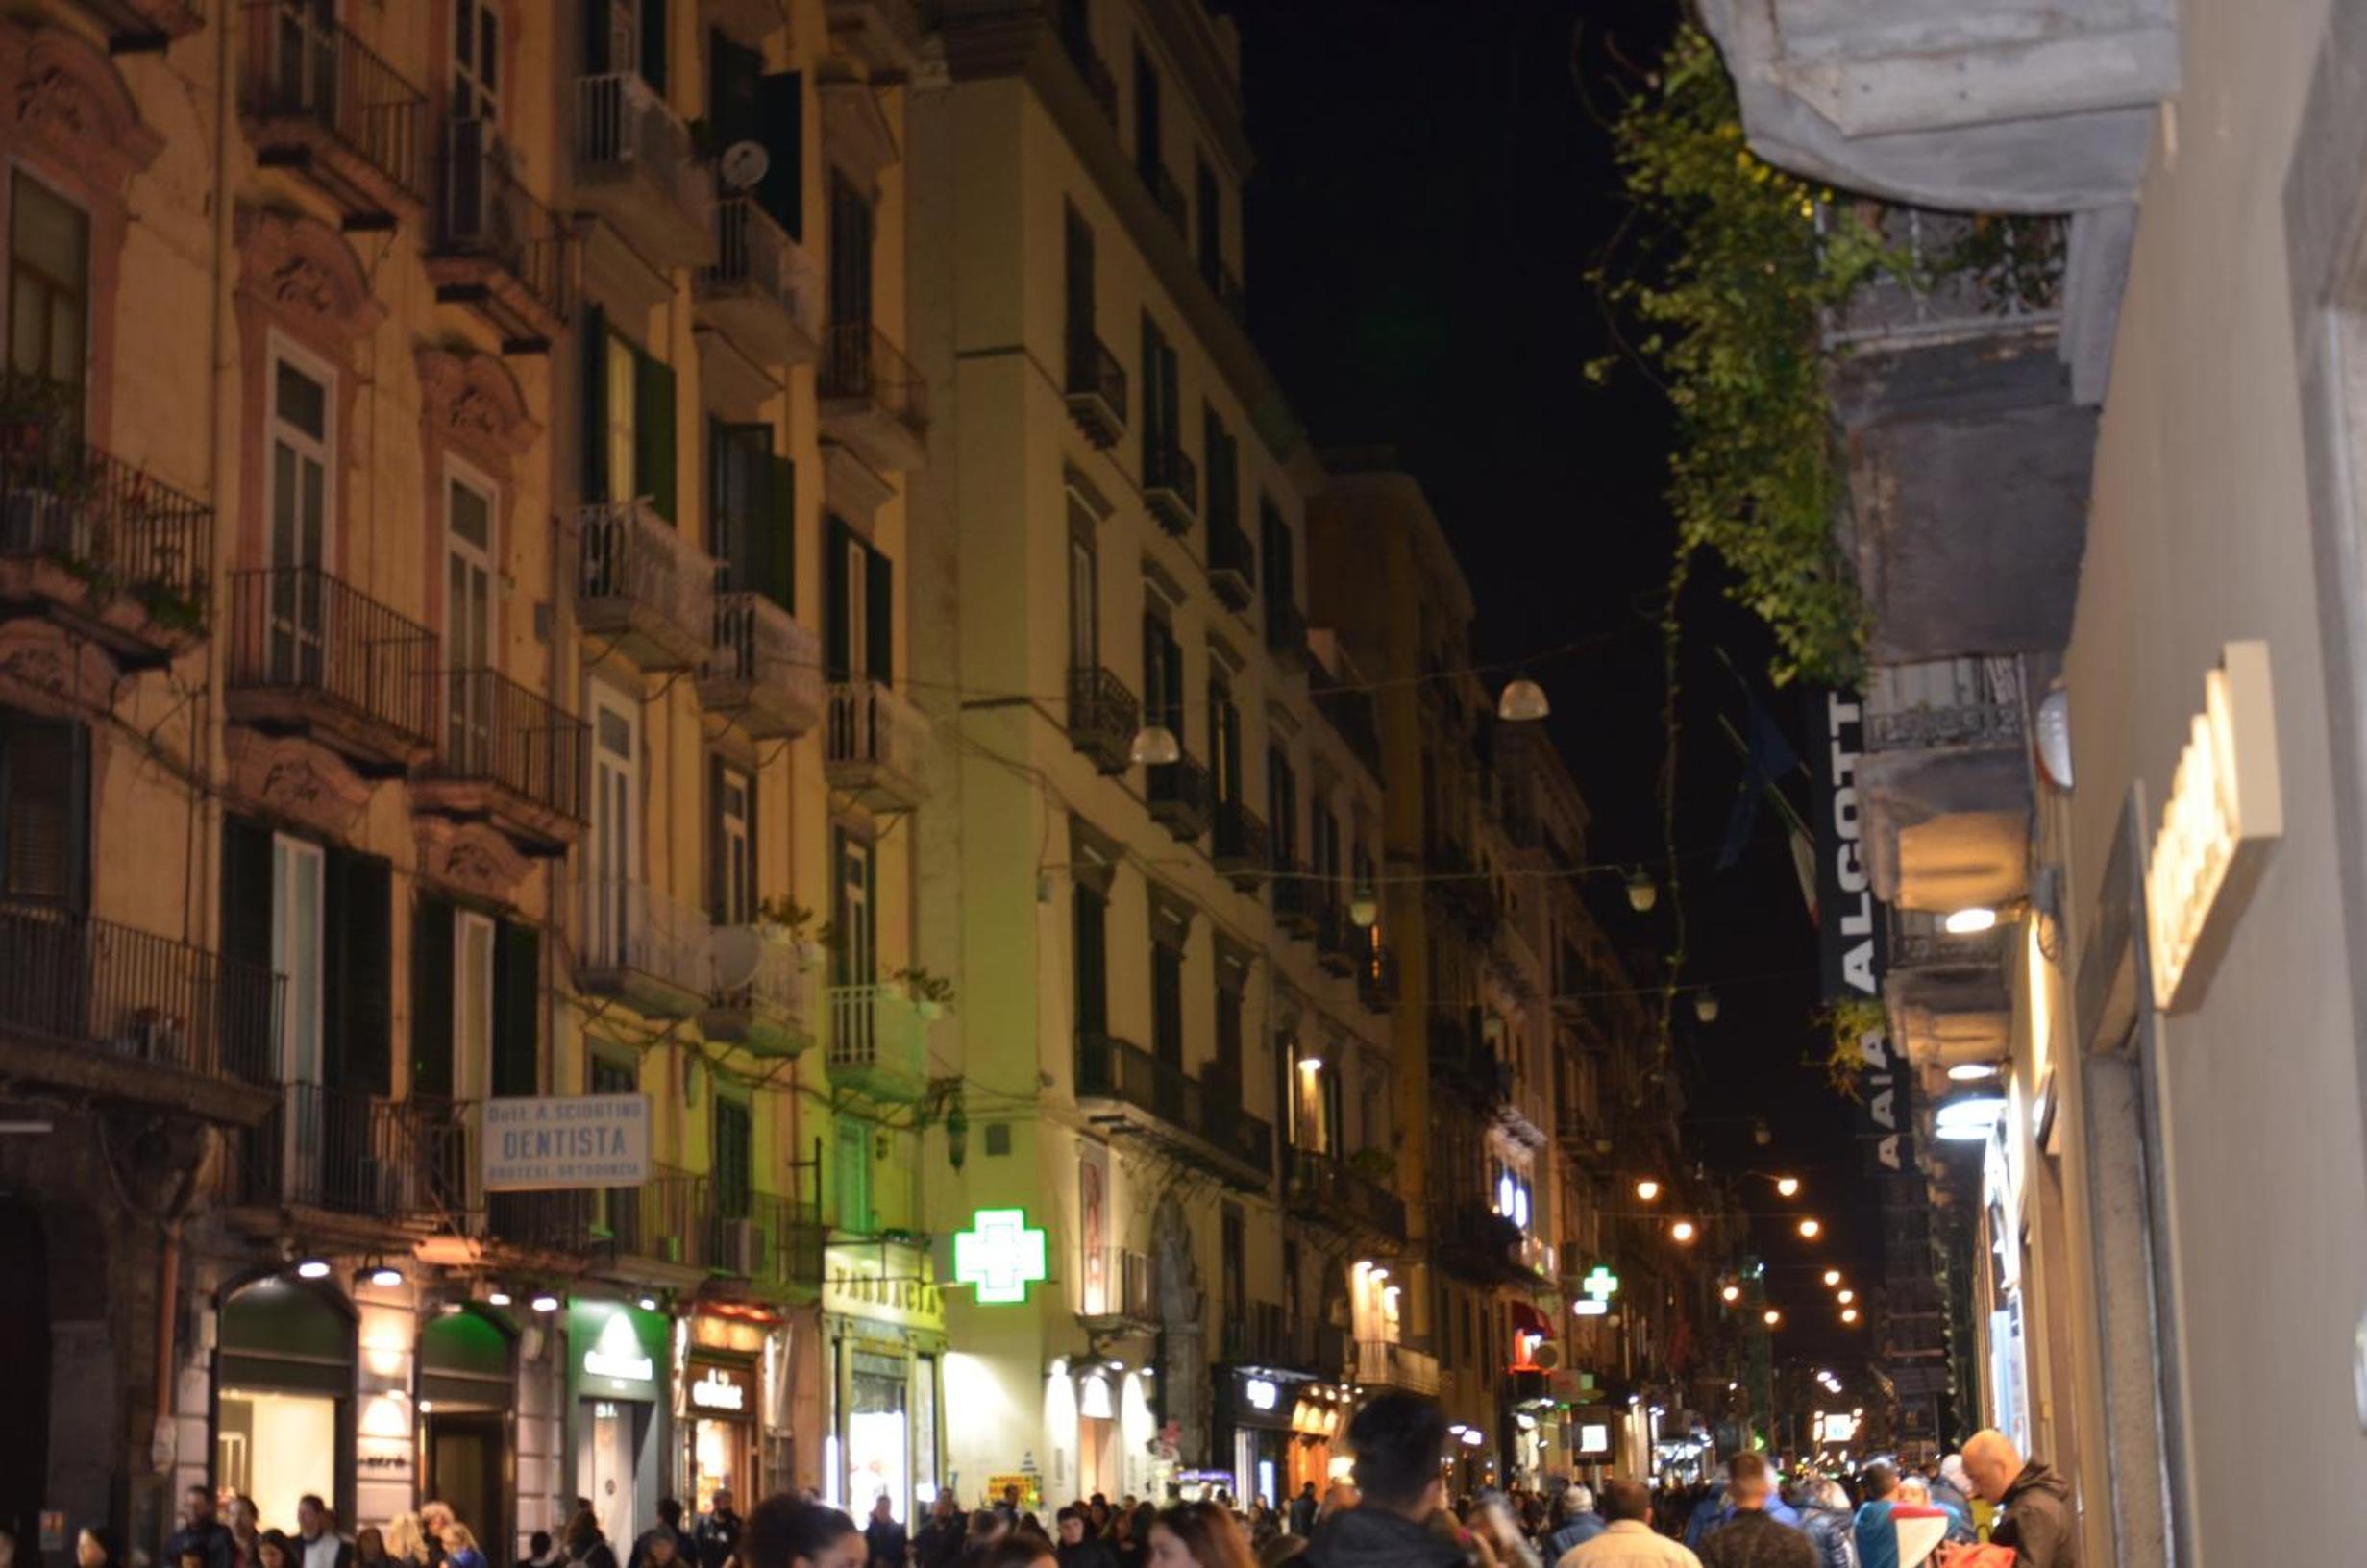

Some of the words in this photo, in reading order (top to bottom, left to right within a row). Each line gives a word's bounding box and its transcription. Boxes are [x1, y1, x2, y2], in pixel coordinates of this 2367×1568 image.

[1828, 690, 1877, 994] ALCOTT
[503, 1126, 628, 1160] DENTISTA
[834, 1266, 937, 1316] FARMACIA
